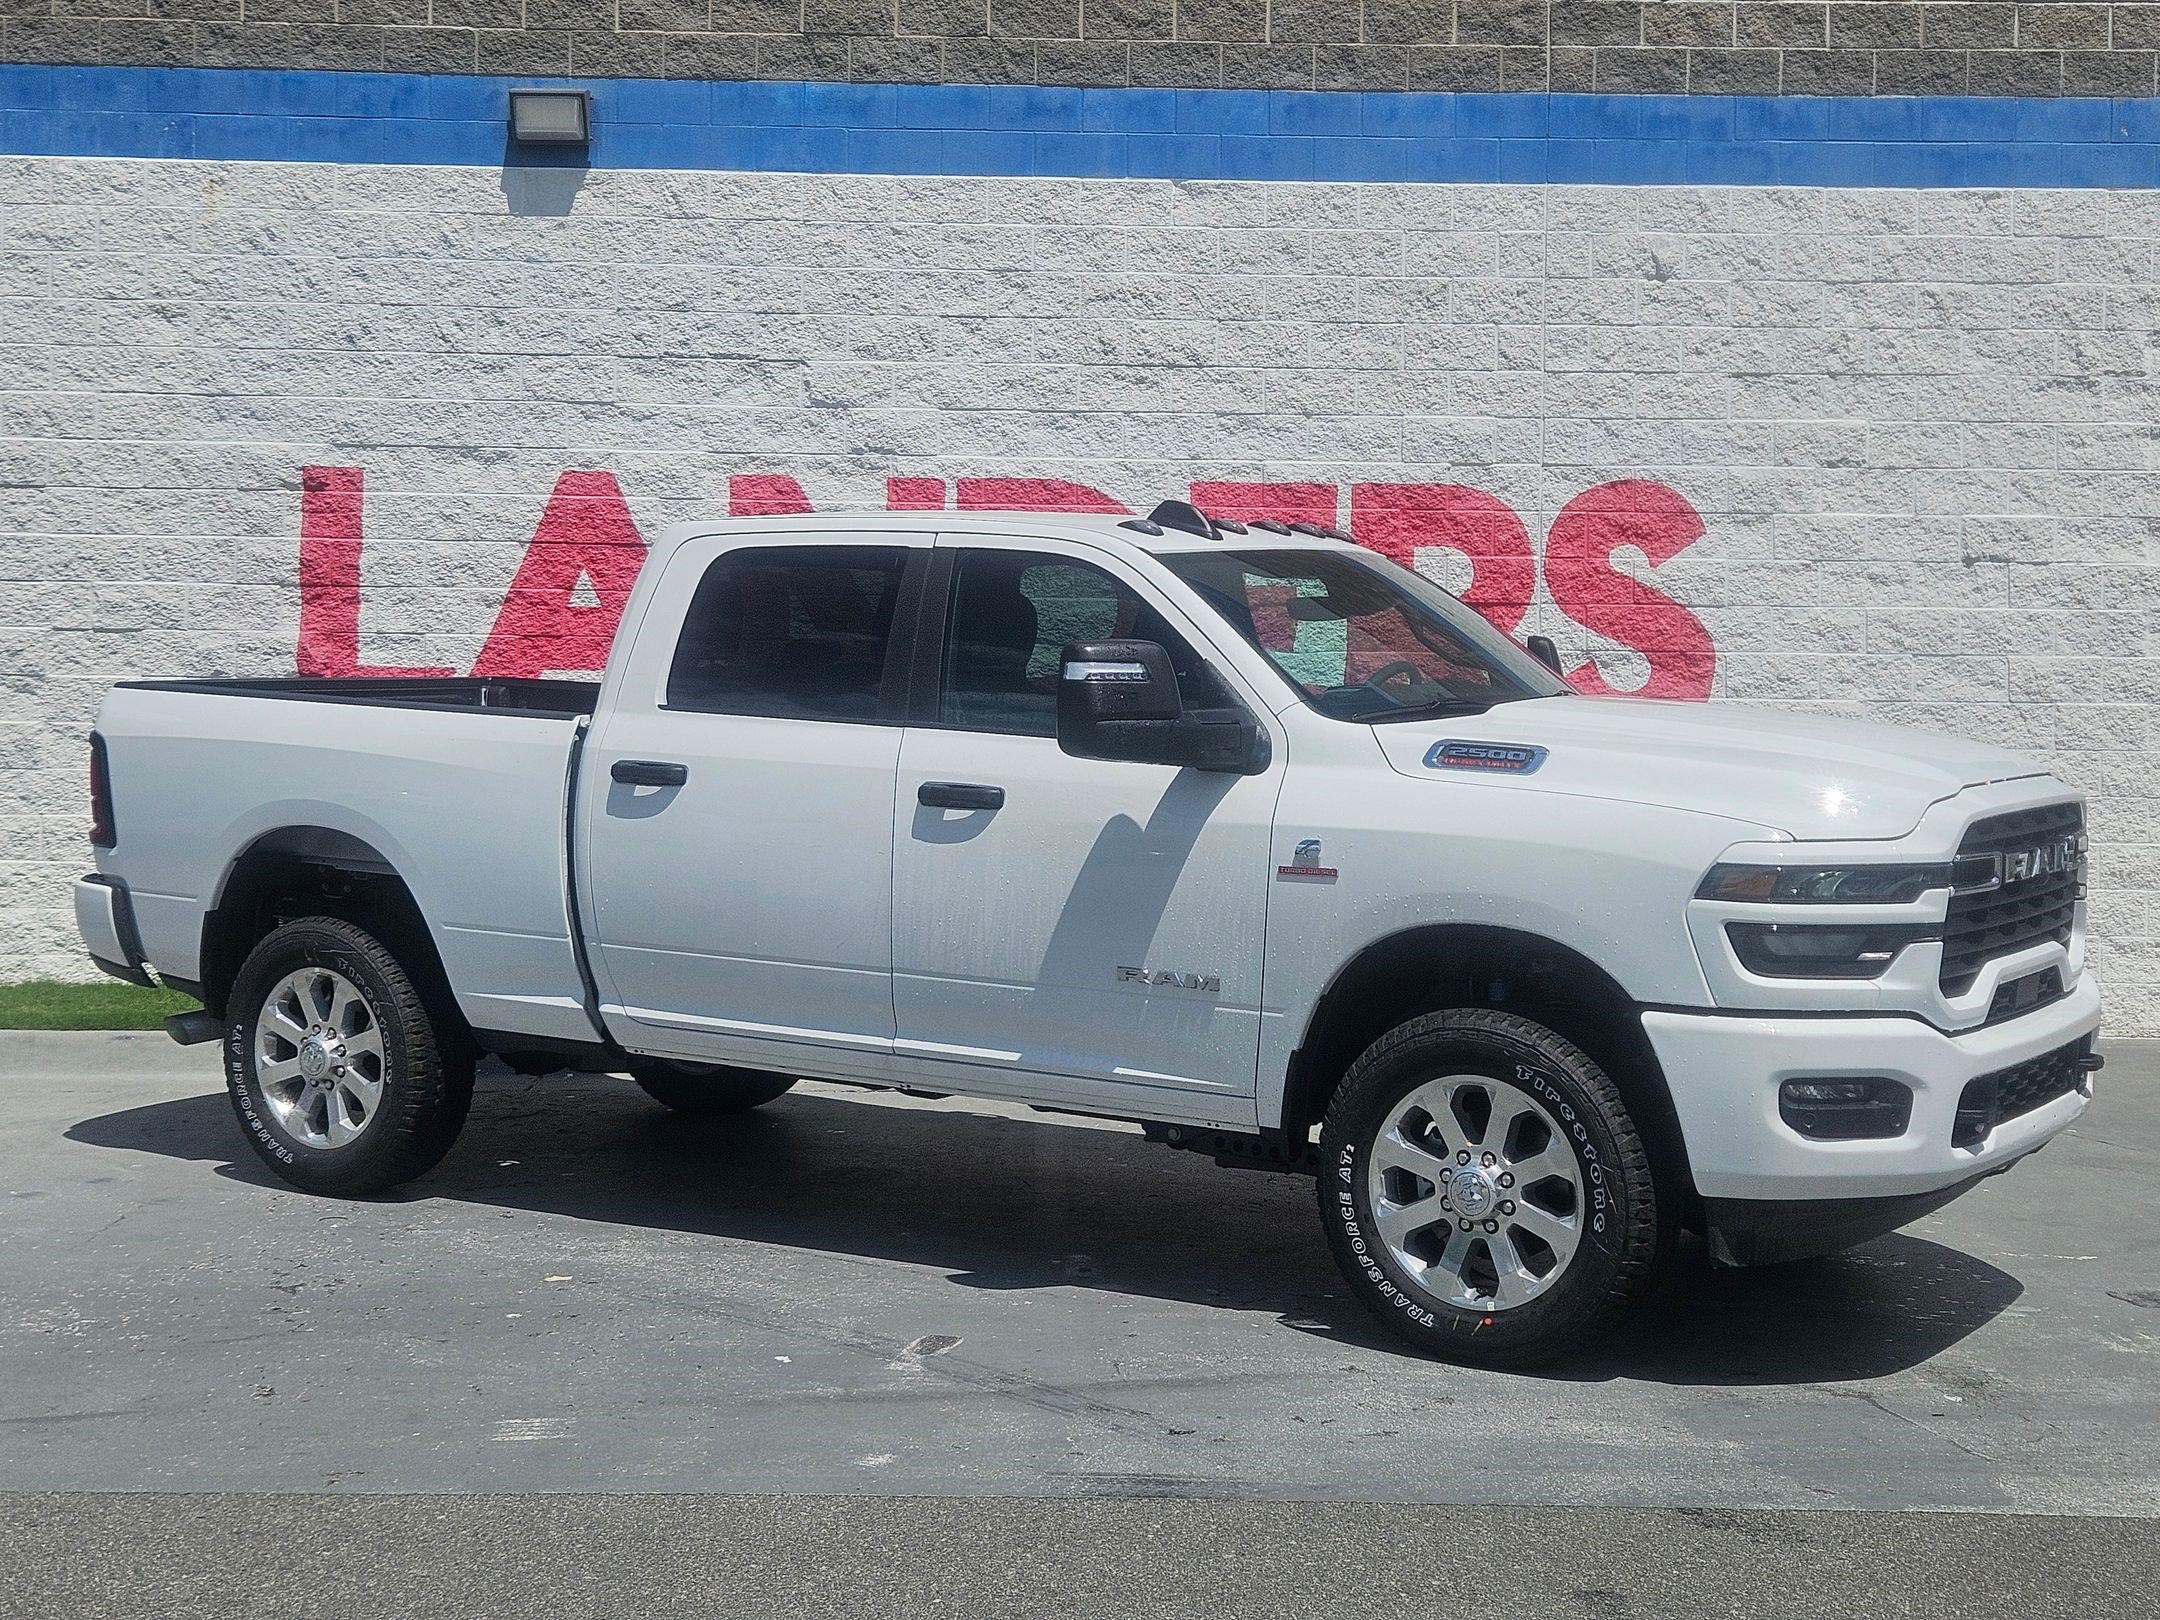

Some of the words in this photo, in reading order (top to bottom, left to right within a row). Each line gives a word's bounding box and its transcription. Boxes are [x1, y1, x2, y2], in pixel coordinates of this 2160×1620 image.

[297, 466, 1716, 700] LAERS
[1448, 746, 1527, 762] 2500
[2004, 837, 2076, 884] RAM
[1116, 965, 1221, 992] RAM
[1338, 1143, 1356, 1184] AT2
[1515, 1064, 1606, 1233] Firestone
[1339, 1191, 1435, 1328] TRANSFORCE
